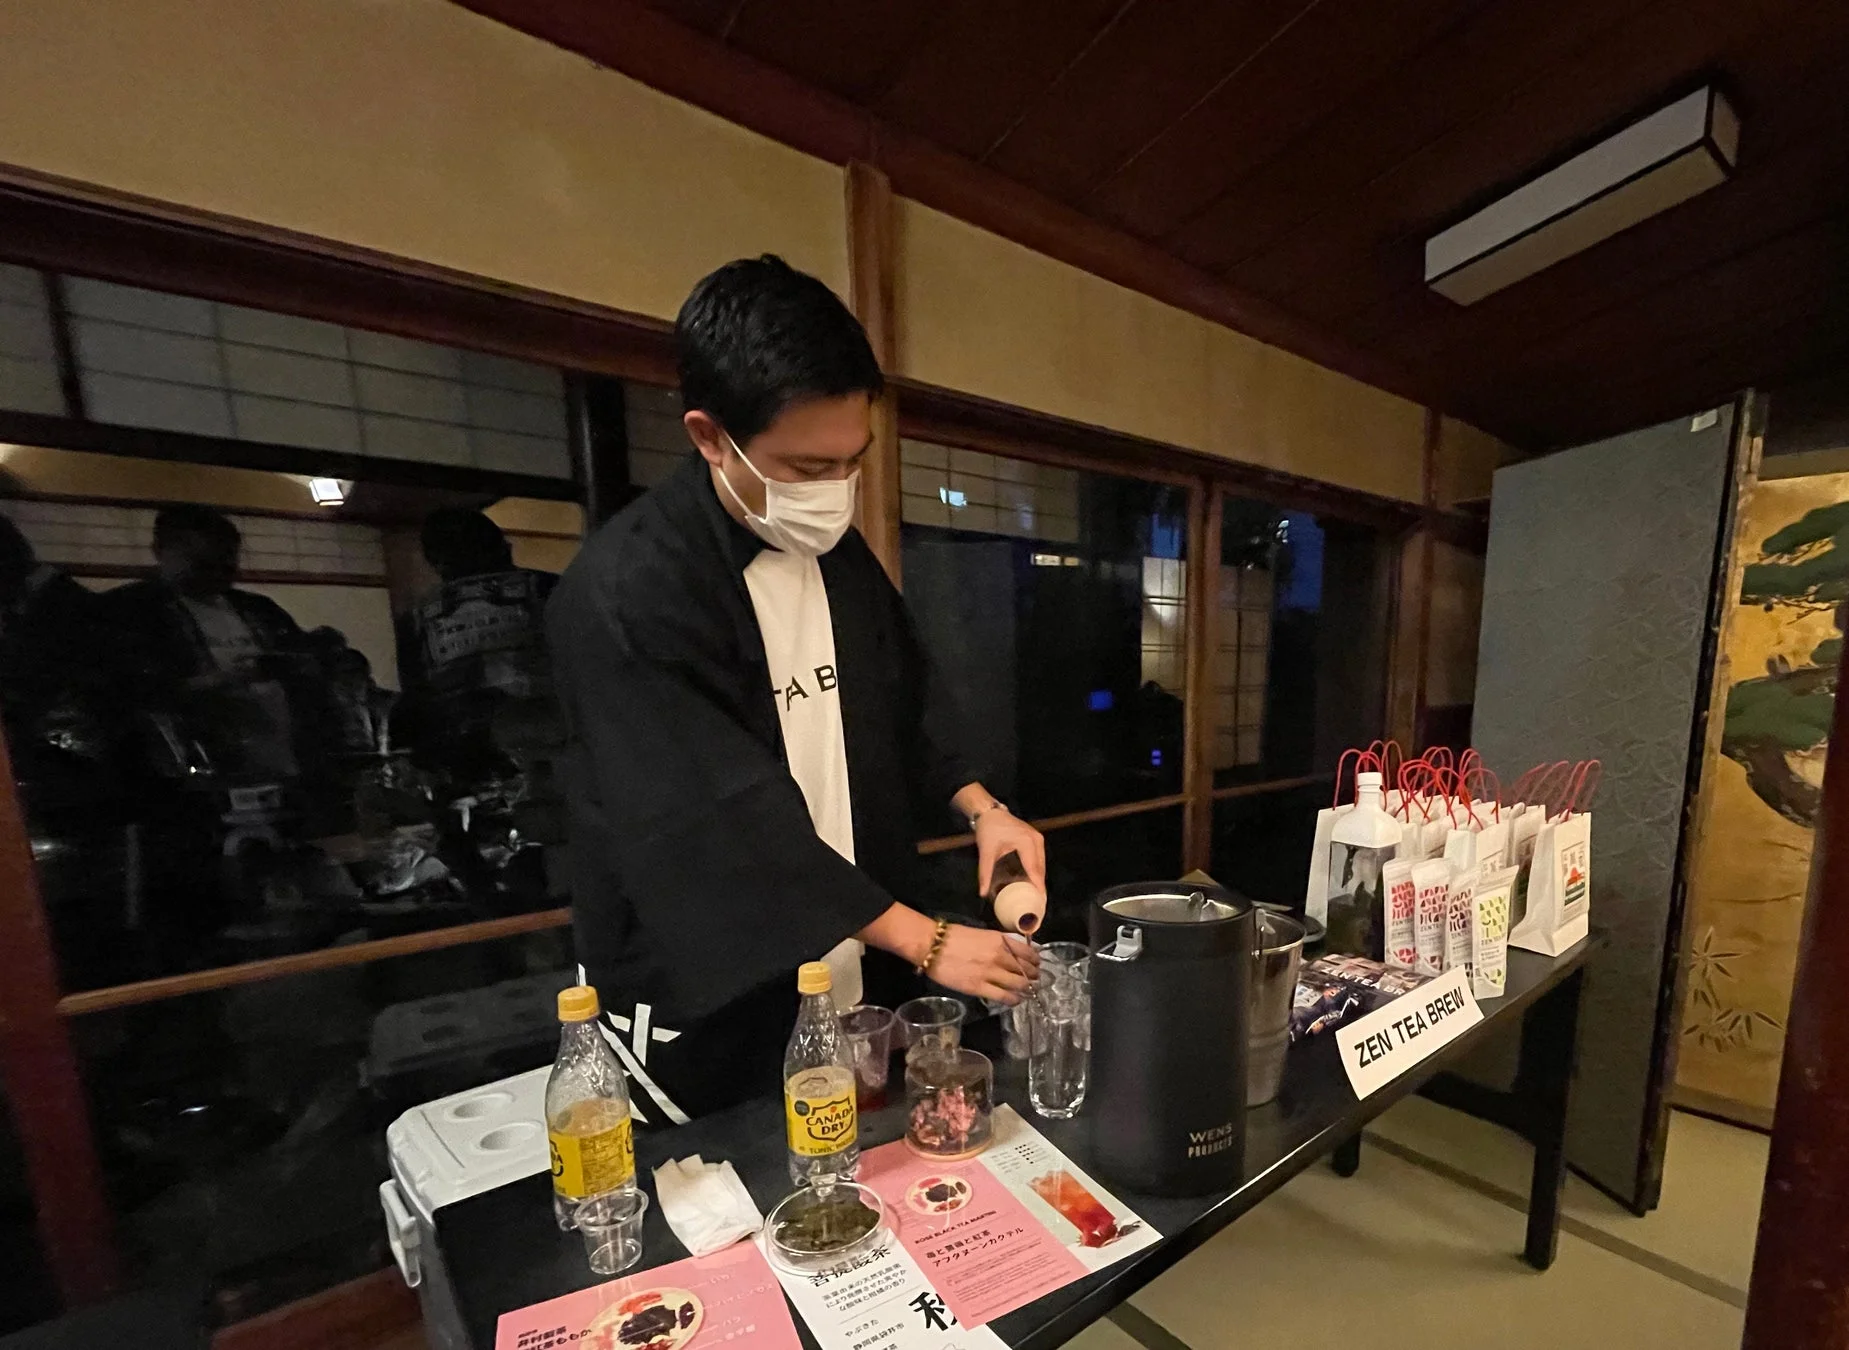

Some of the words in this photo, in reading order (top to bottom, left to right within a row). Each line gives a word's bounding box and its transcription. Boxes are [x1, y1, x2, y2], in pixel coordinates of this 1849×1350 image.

[1321, 966, 1352, 980] ZEN
[1354, 976, 1381, 990] TEA
[1353, 1028, 1394, 1069] ZEN
[1391, 1010, 1428, 1044] TEA
[1425, 986, 1465, 1026] BREW
[806, 1104, 854, 1126] CANADA
[821, 1120, 845, 1136] DRY
[1189, 1121, 1233, 1144] WENS
